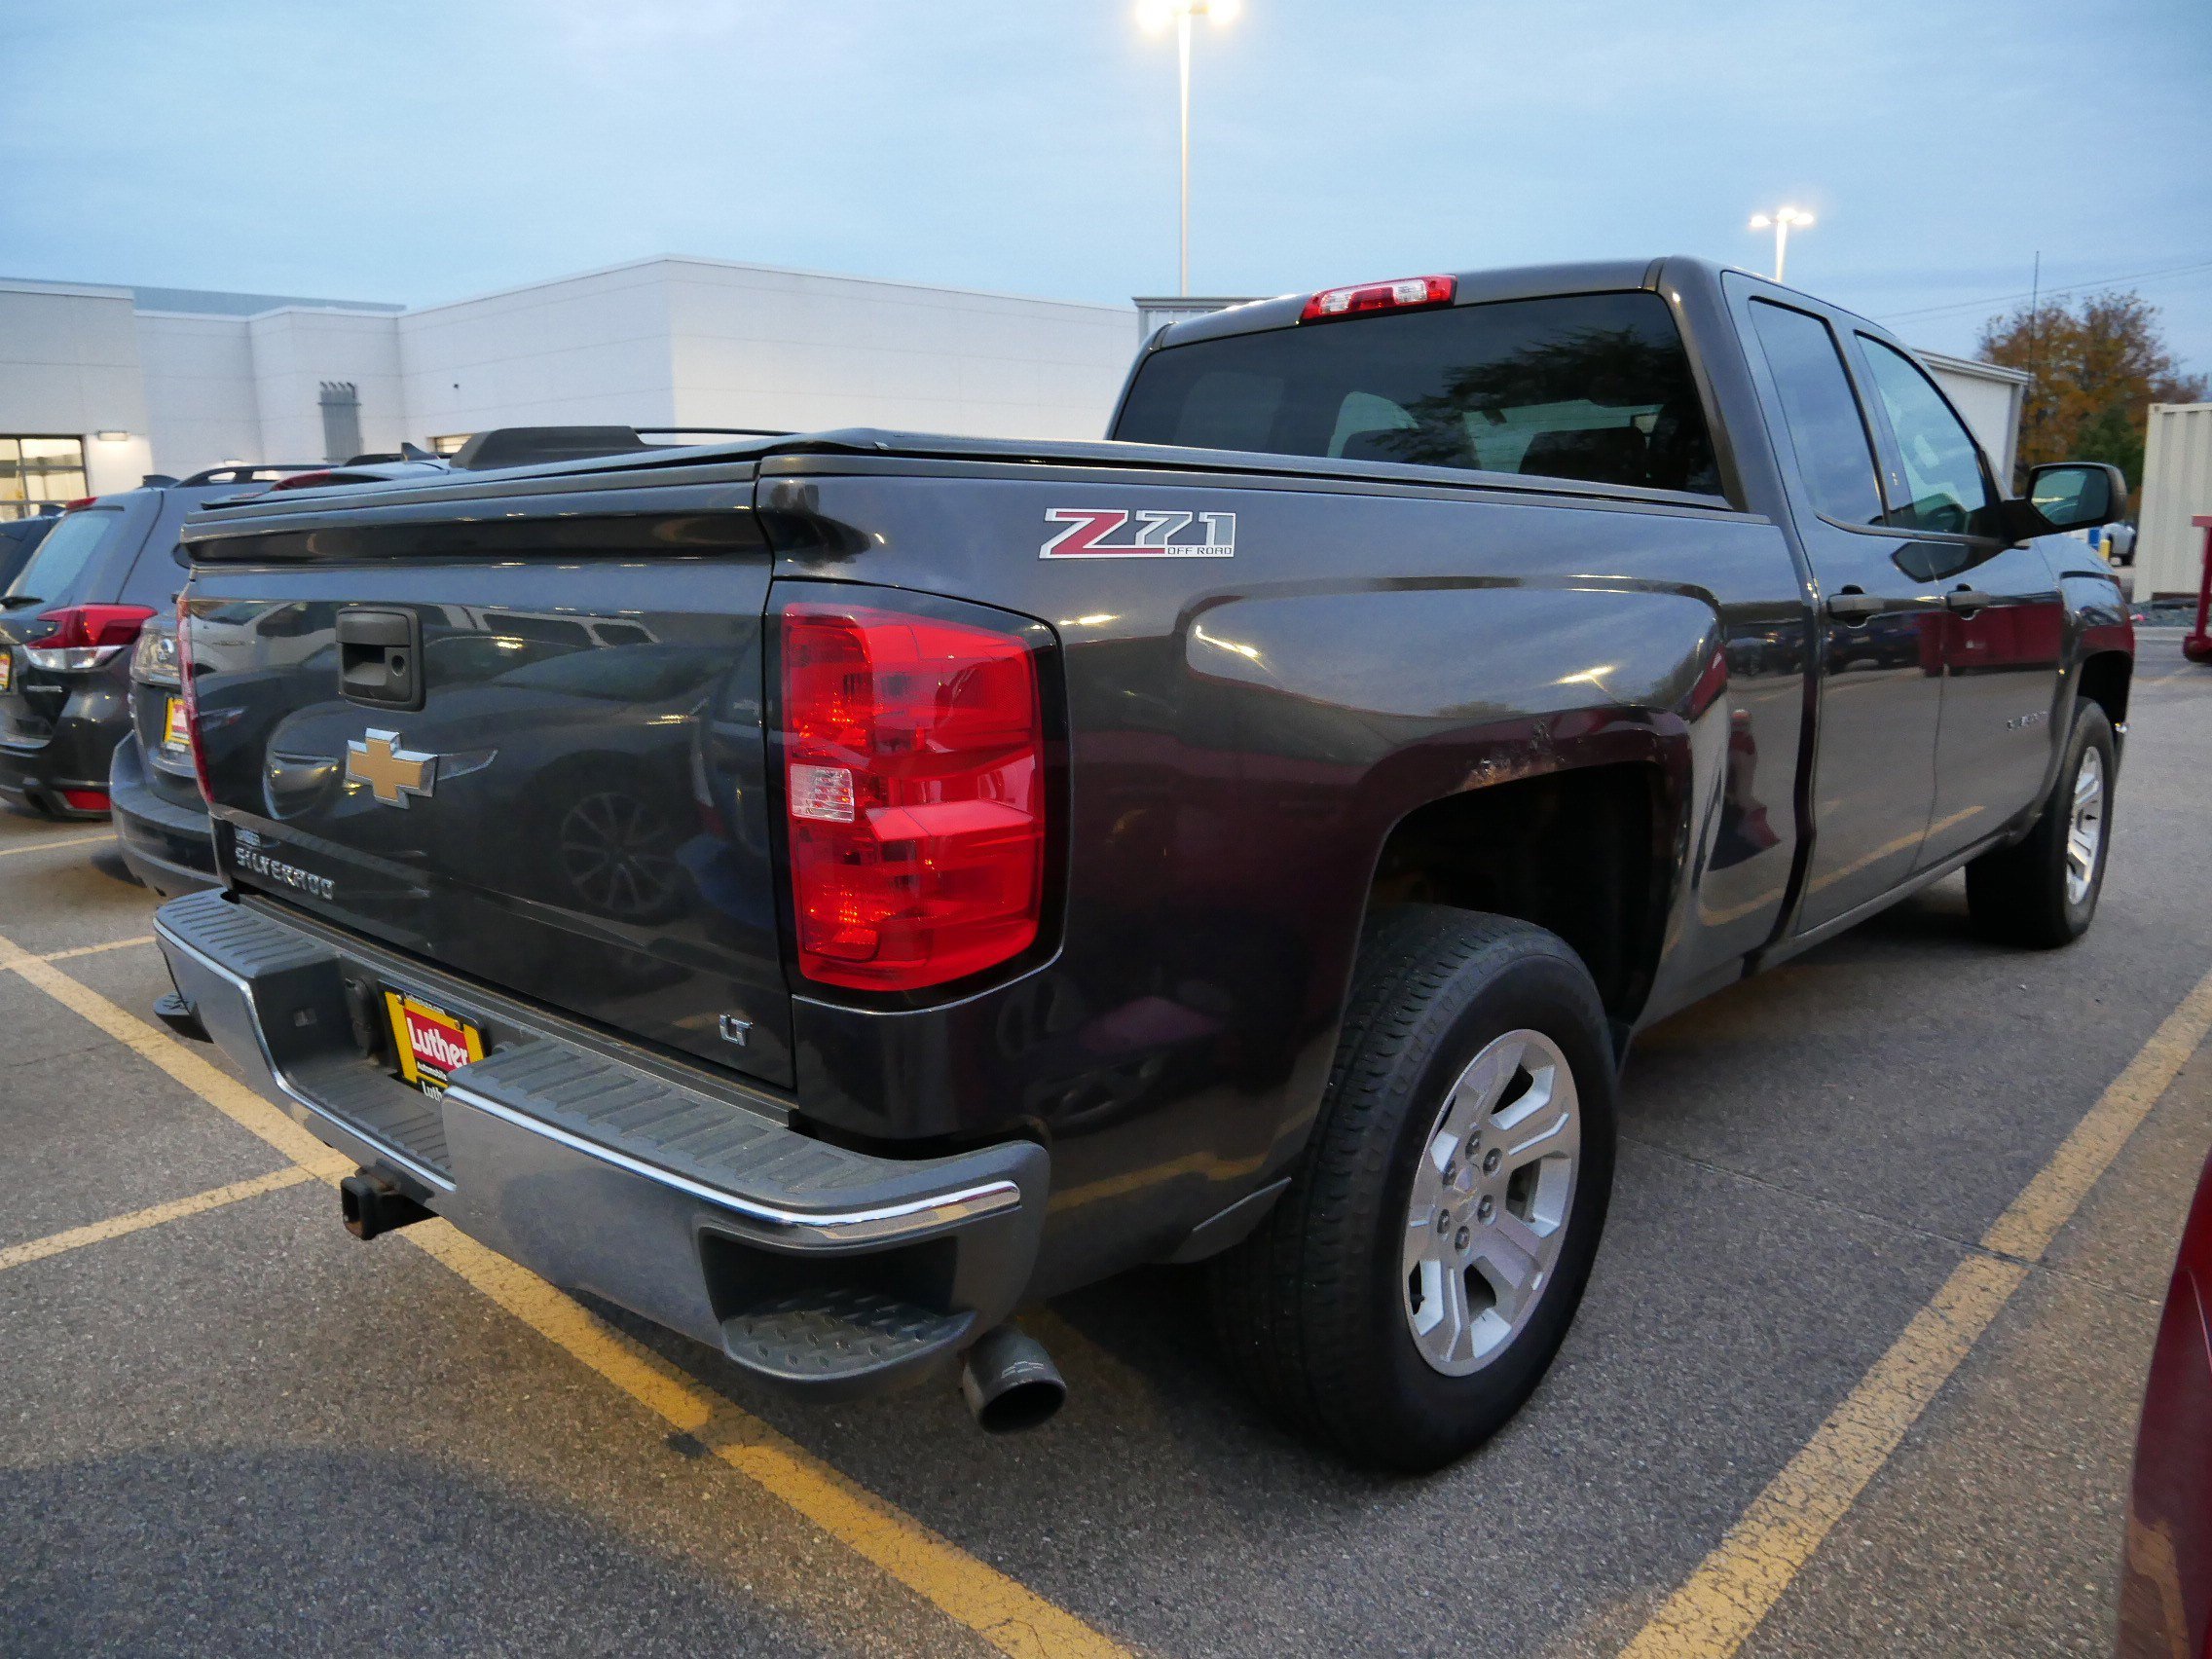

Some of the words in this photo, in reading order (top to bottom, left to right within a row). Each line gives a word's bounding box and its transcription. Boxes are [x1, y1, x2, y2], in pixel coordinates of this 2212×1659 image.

[1039, 507, 1236, 559] Z71
[406, 1016, 468, 1069] Luther
[719, 1014, 754, 1047] LT
